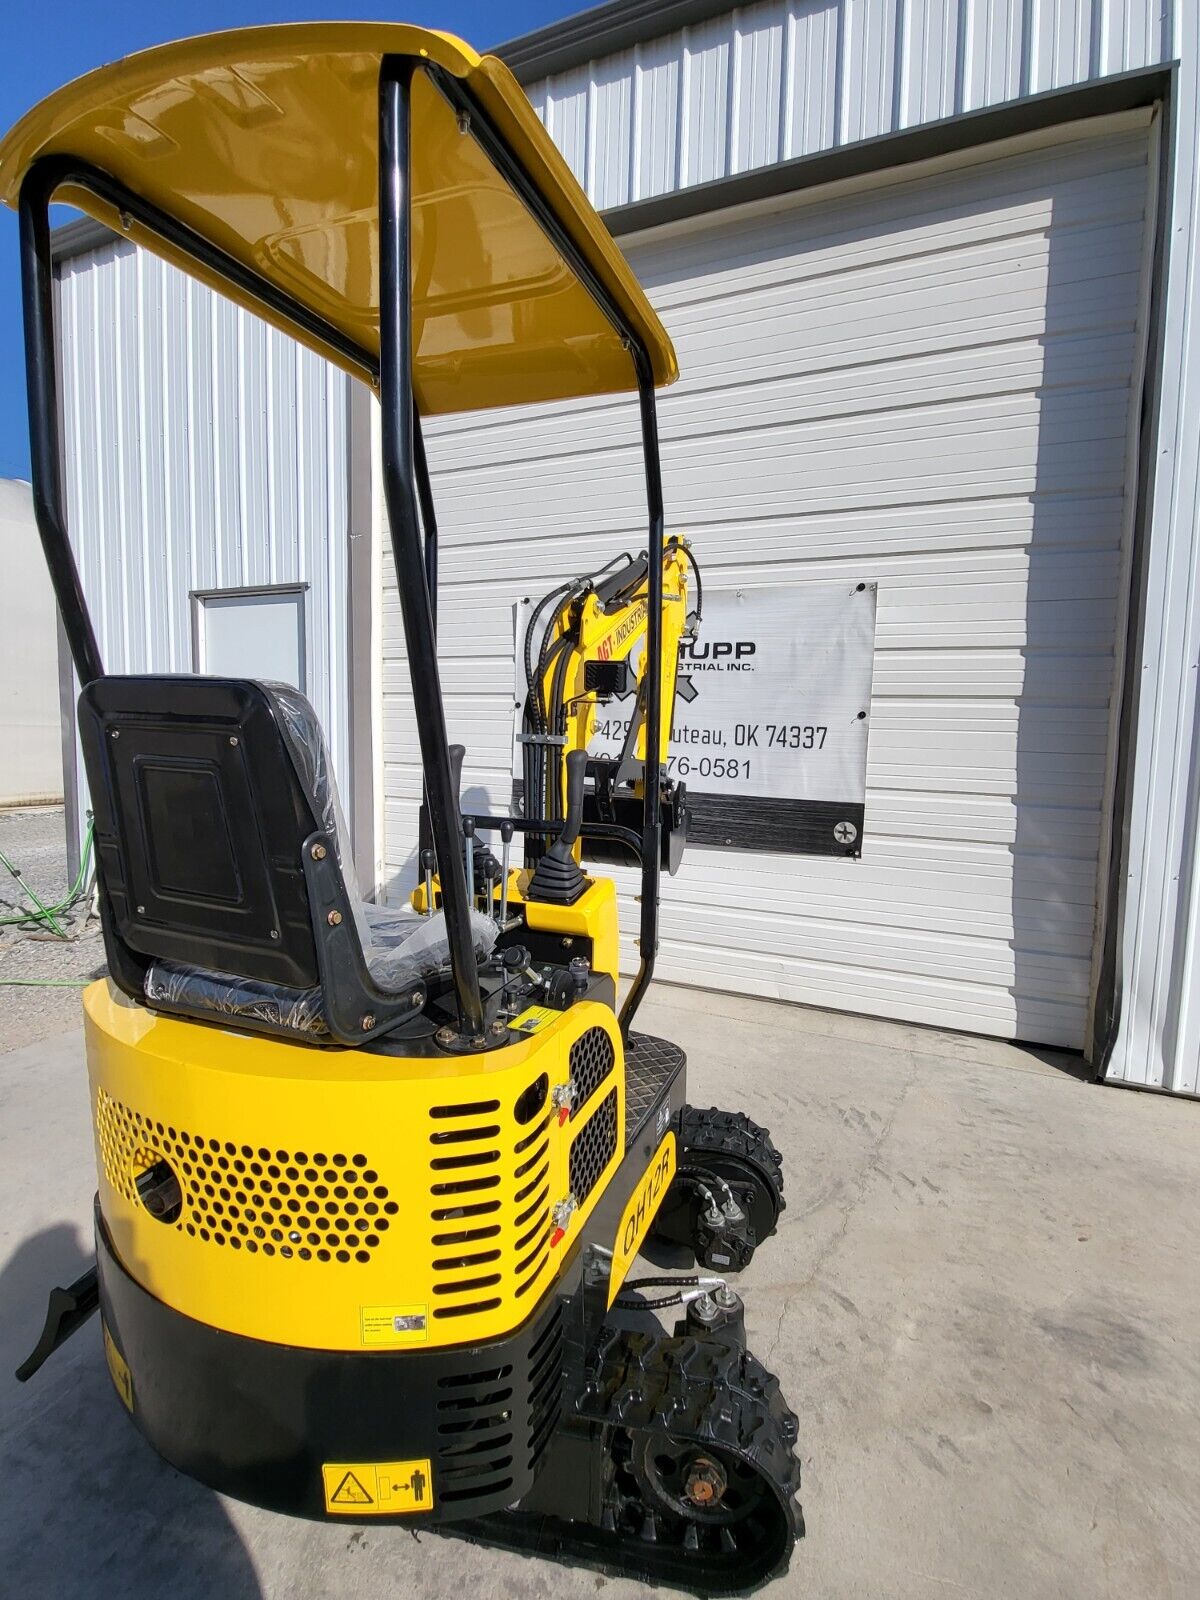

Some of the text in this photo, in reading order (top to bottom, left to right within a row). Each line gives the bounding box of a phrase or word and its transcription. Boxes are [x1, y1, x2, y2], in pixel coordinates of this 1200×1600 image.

[726, 663, 755, 671] INC.
[734, 724, 759, 747] OK
[766, 725, 828, 750] 74337
[623, 1147, 670, 1257] QH12R
